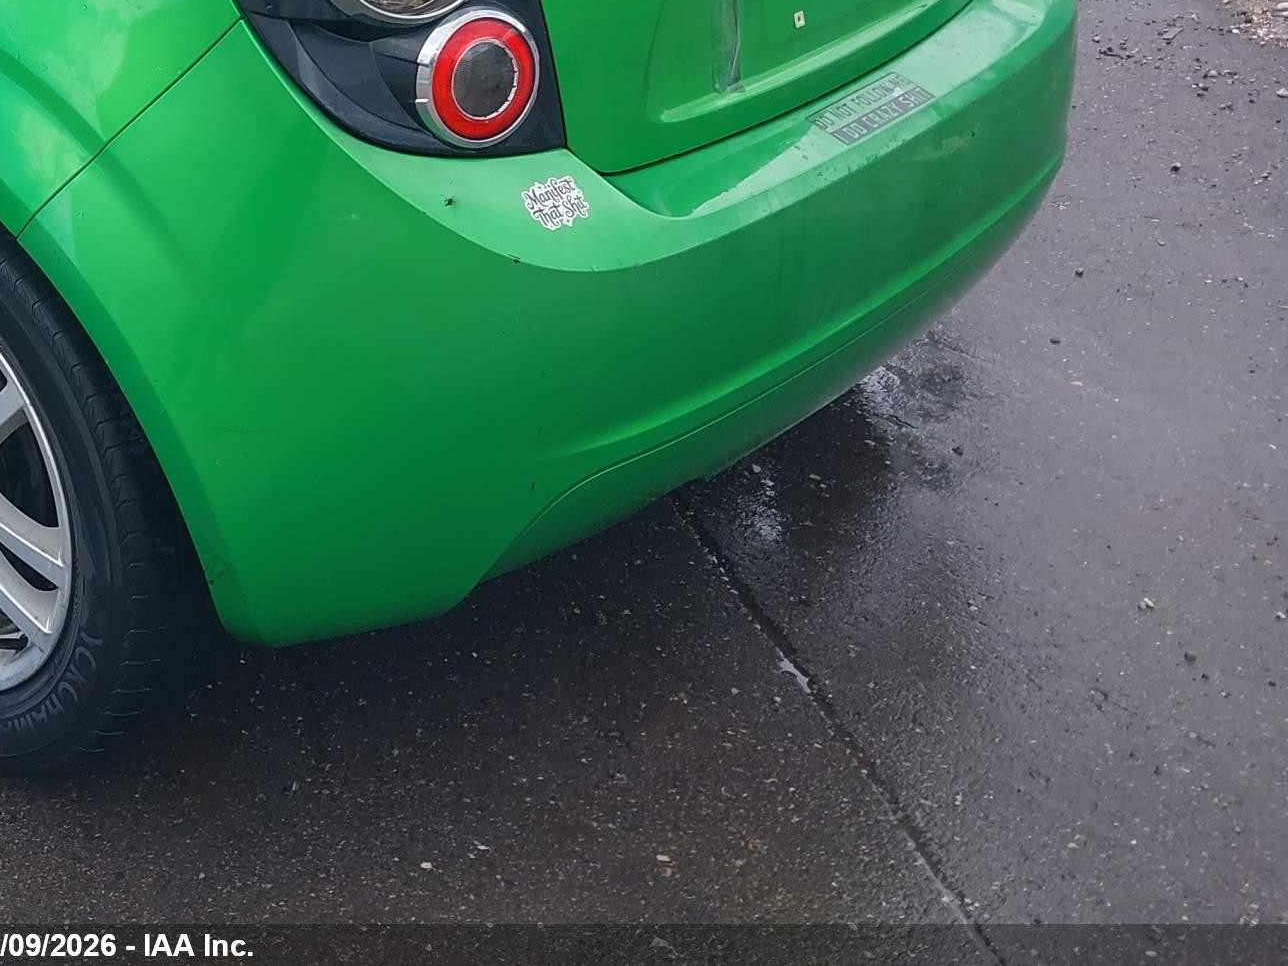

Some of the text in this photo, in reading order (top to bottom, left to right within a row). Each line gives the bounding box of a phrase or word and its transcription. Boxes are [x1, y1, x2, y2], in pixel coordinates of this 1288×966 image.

[827, 102, 857, 122] NOT
[842, 123, 868, 139] DO
[862, 102, 905, 128] CRAZY
[523, 178, 576, 211] Manifest
[532, 194, 589, 227] That Shit
